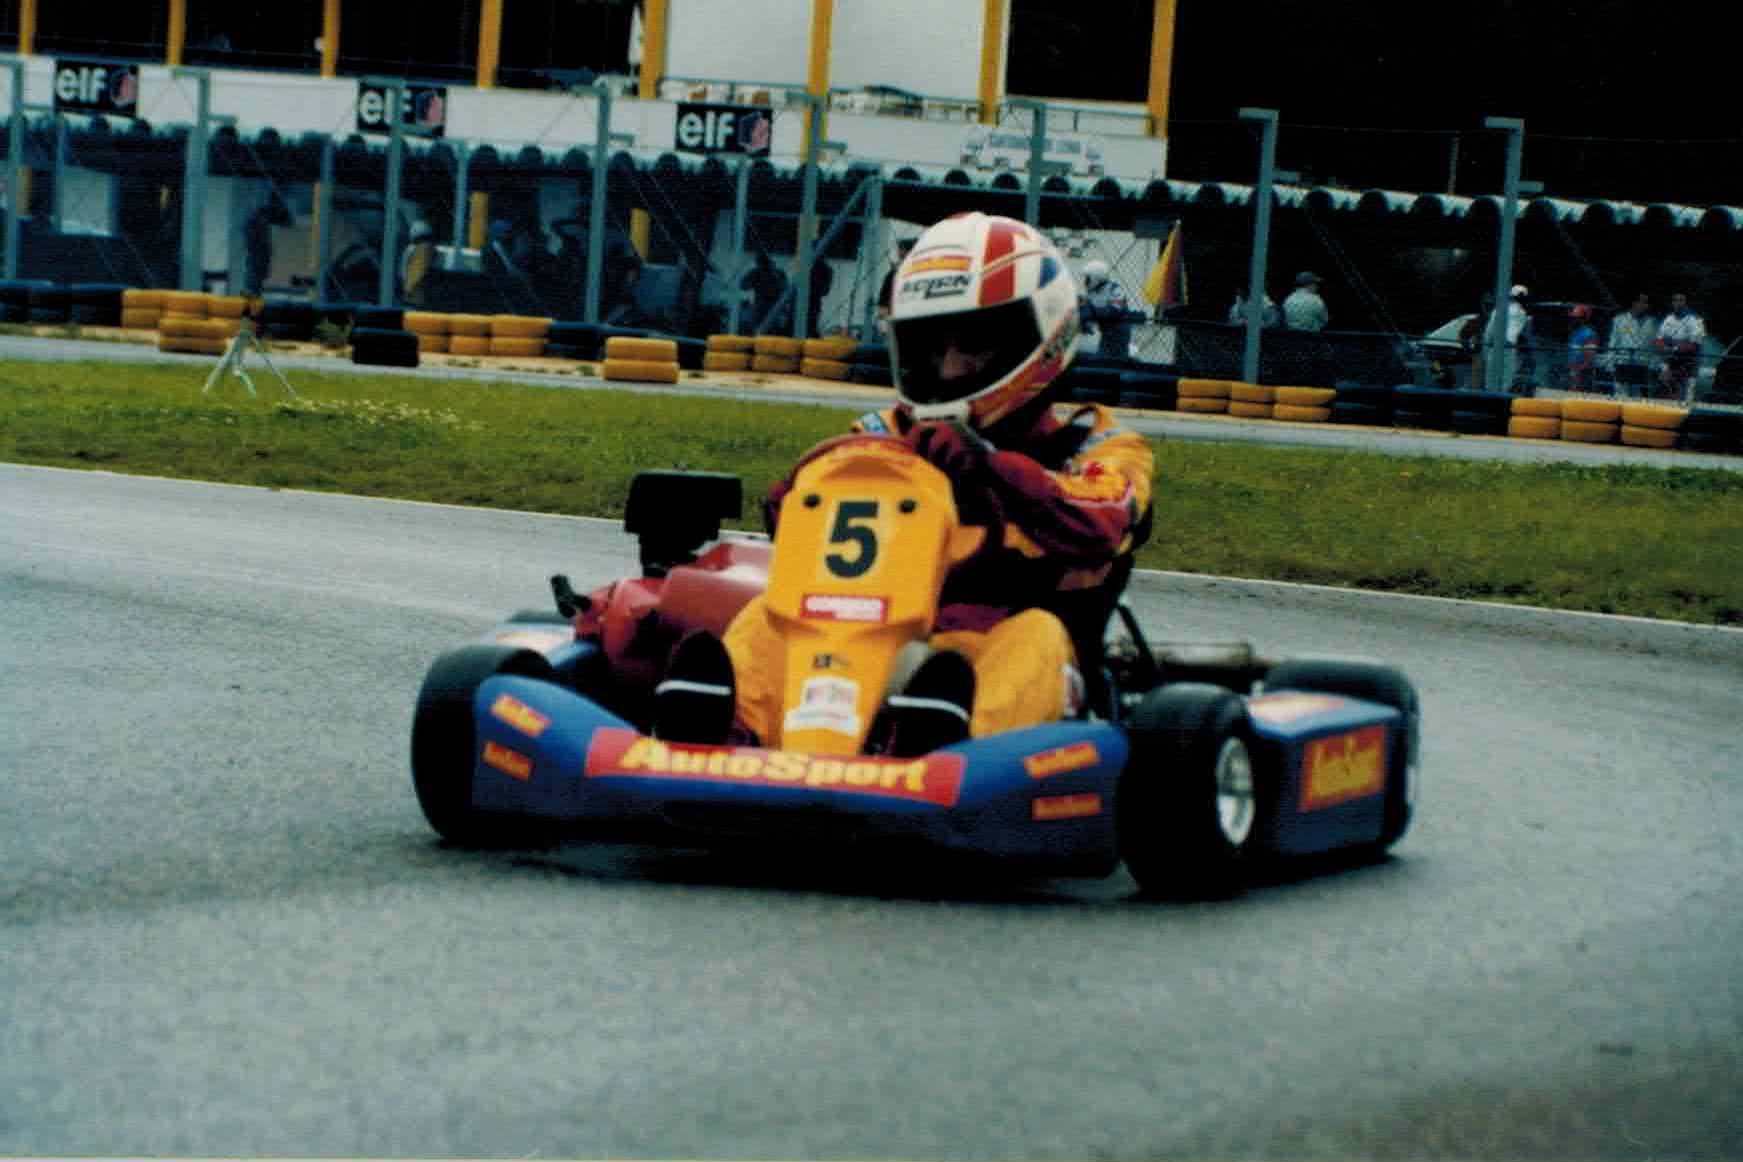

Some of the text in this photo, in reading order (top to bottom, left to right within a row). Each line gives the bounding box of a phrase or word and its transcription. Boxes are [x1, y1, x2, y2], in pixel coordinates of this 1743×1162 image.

[56, 66, 106, 103] elf
[360, 87, 412, 125] elf
[679, 111, 734, 149] elf
[825, 501, 879, 578] 5
[619, 735, 927, 793] AutoSport
